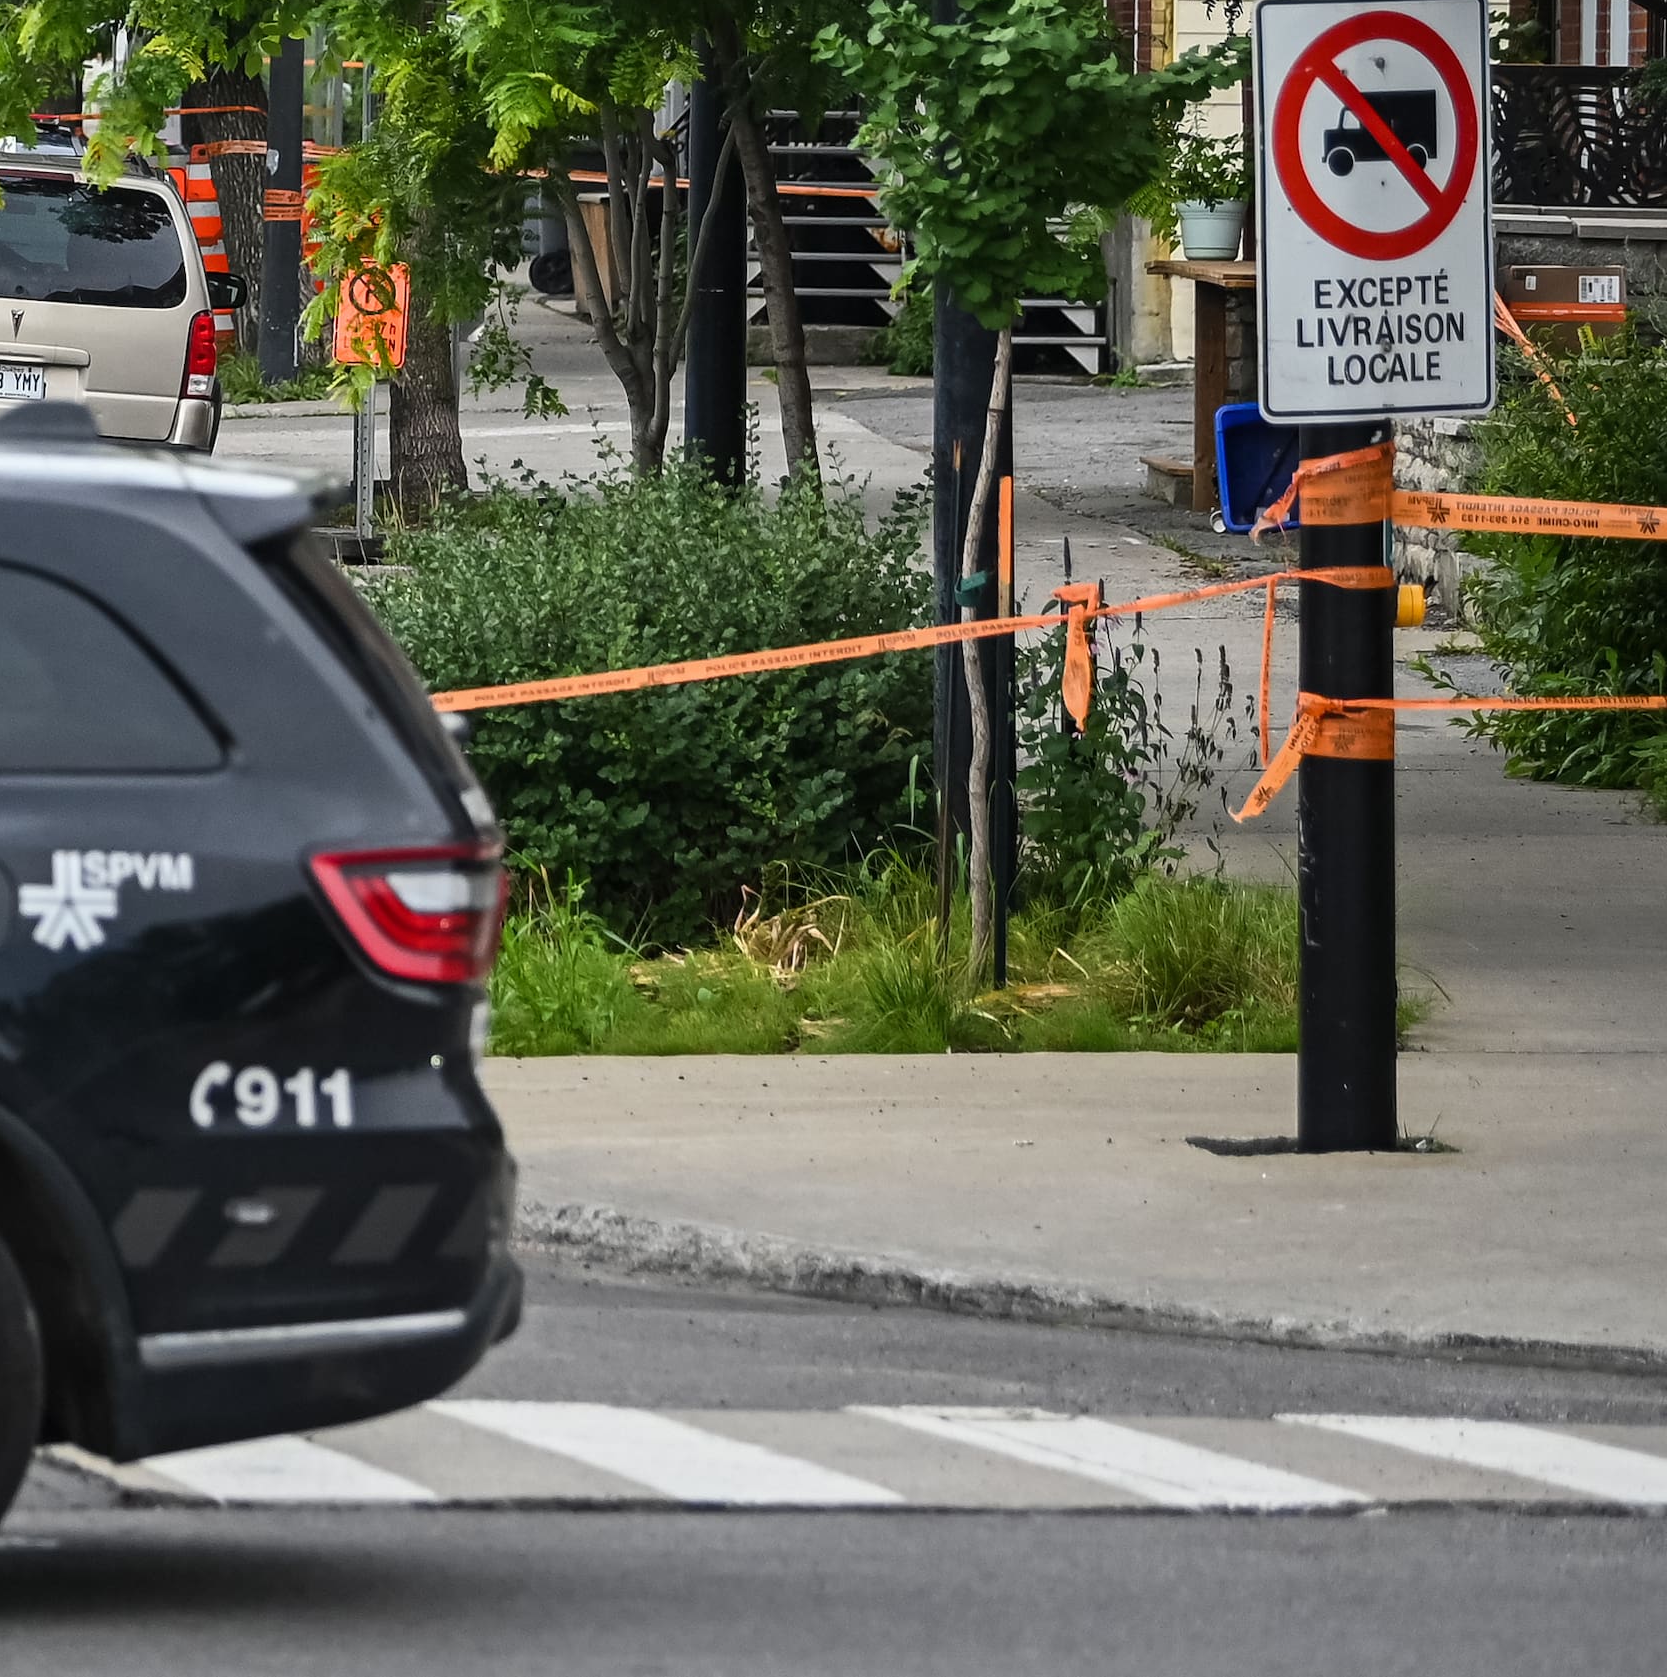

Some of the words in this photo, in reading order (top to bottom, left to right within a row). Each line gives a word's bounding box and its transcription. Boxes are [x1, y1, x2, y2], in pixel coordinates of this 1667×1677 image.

[1314, 269, 1449, 309] EXCEPTÉ
[1297, 311, 1465, 348] LIVRAISON
[14, 372, 41, 393] YMY
[1327, 351, 1442, 386] LOCALE
[936, 626, 978, 639] POLICE
[981, 621, 1018, 634] PASS
[705, 661, 748, 673] POLICE
[750, 652, 806, 667] PASSAGE
[808, 643, 863, 658] INTERDIT
[473, 691, 516, 702] POLICE
[519, 685, 574, 698] PASSAGE
[577, 676, 632, 690] INTERDIT
[85, 850, 193, 891] SPVM
[234, 1066, 353, 1127] 911
